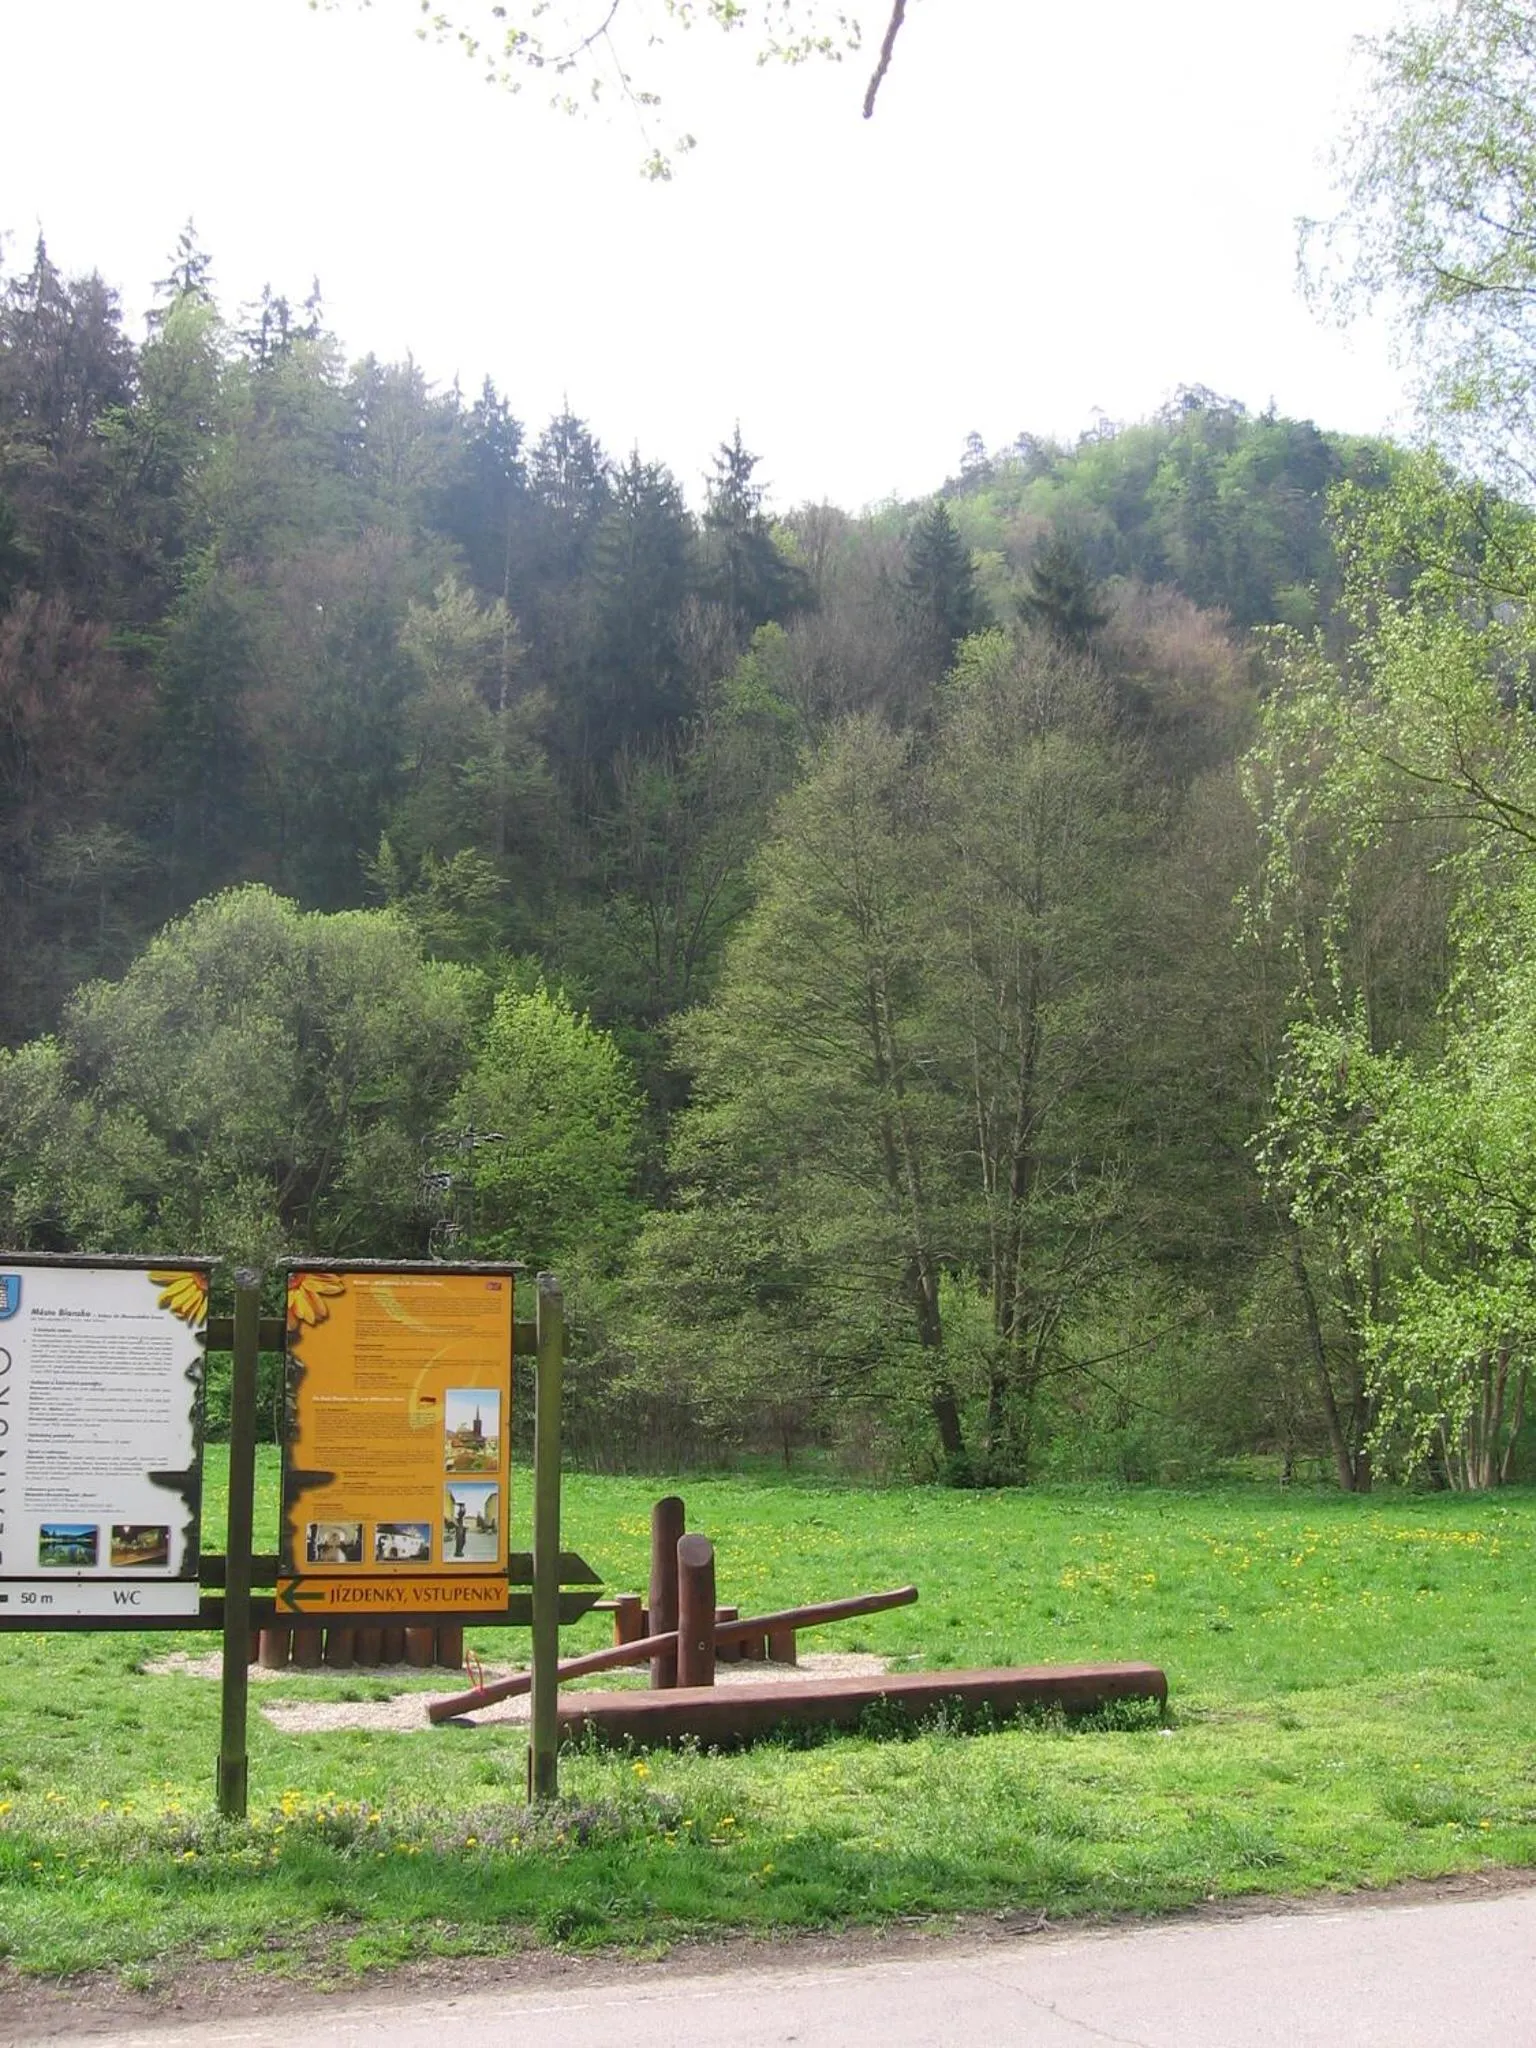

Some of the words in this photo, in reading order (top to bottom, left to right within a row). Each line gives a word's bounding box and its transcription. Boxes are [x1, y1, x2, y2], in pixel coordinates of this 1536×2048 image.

[21, 1592, 36, 1604] 50
[40, 1595, 53, 1604] m
[113, 1590, 141, 1605] WC
[330, 1583, 407, 1604] JÍZDENKY,
[412, 1587, 503, 1601] VSTUPENKY
